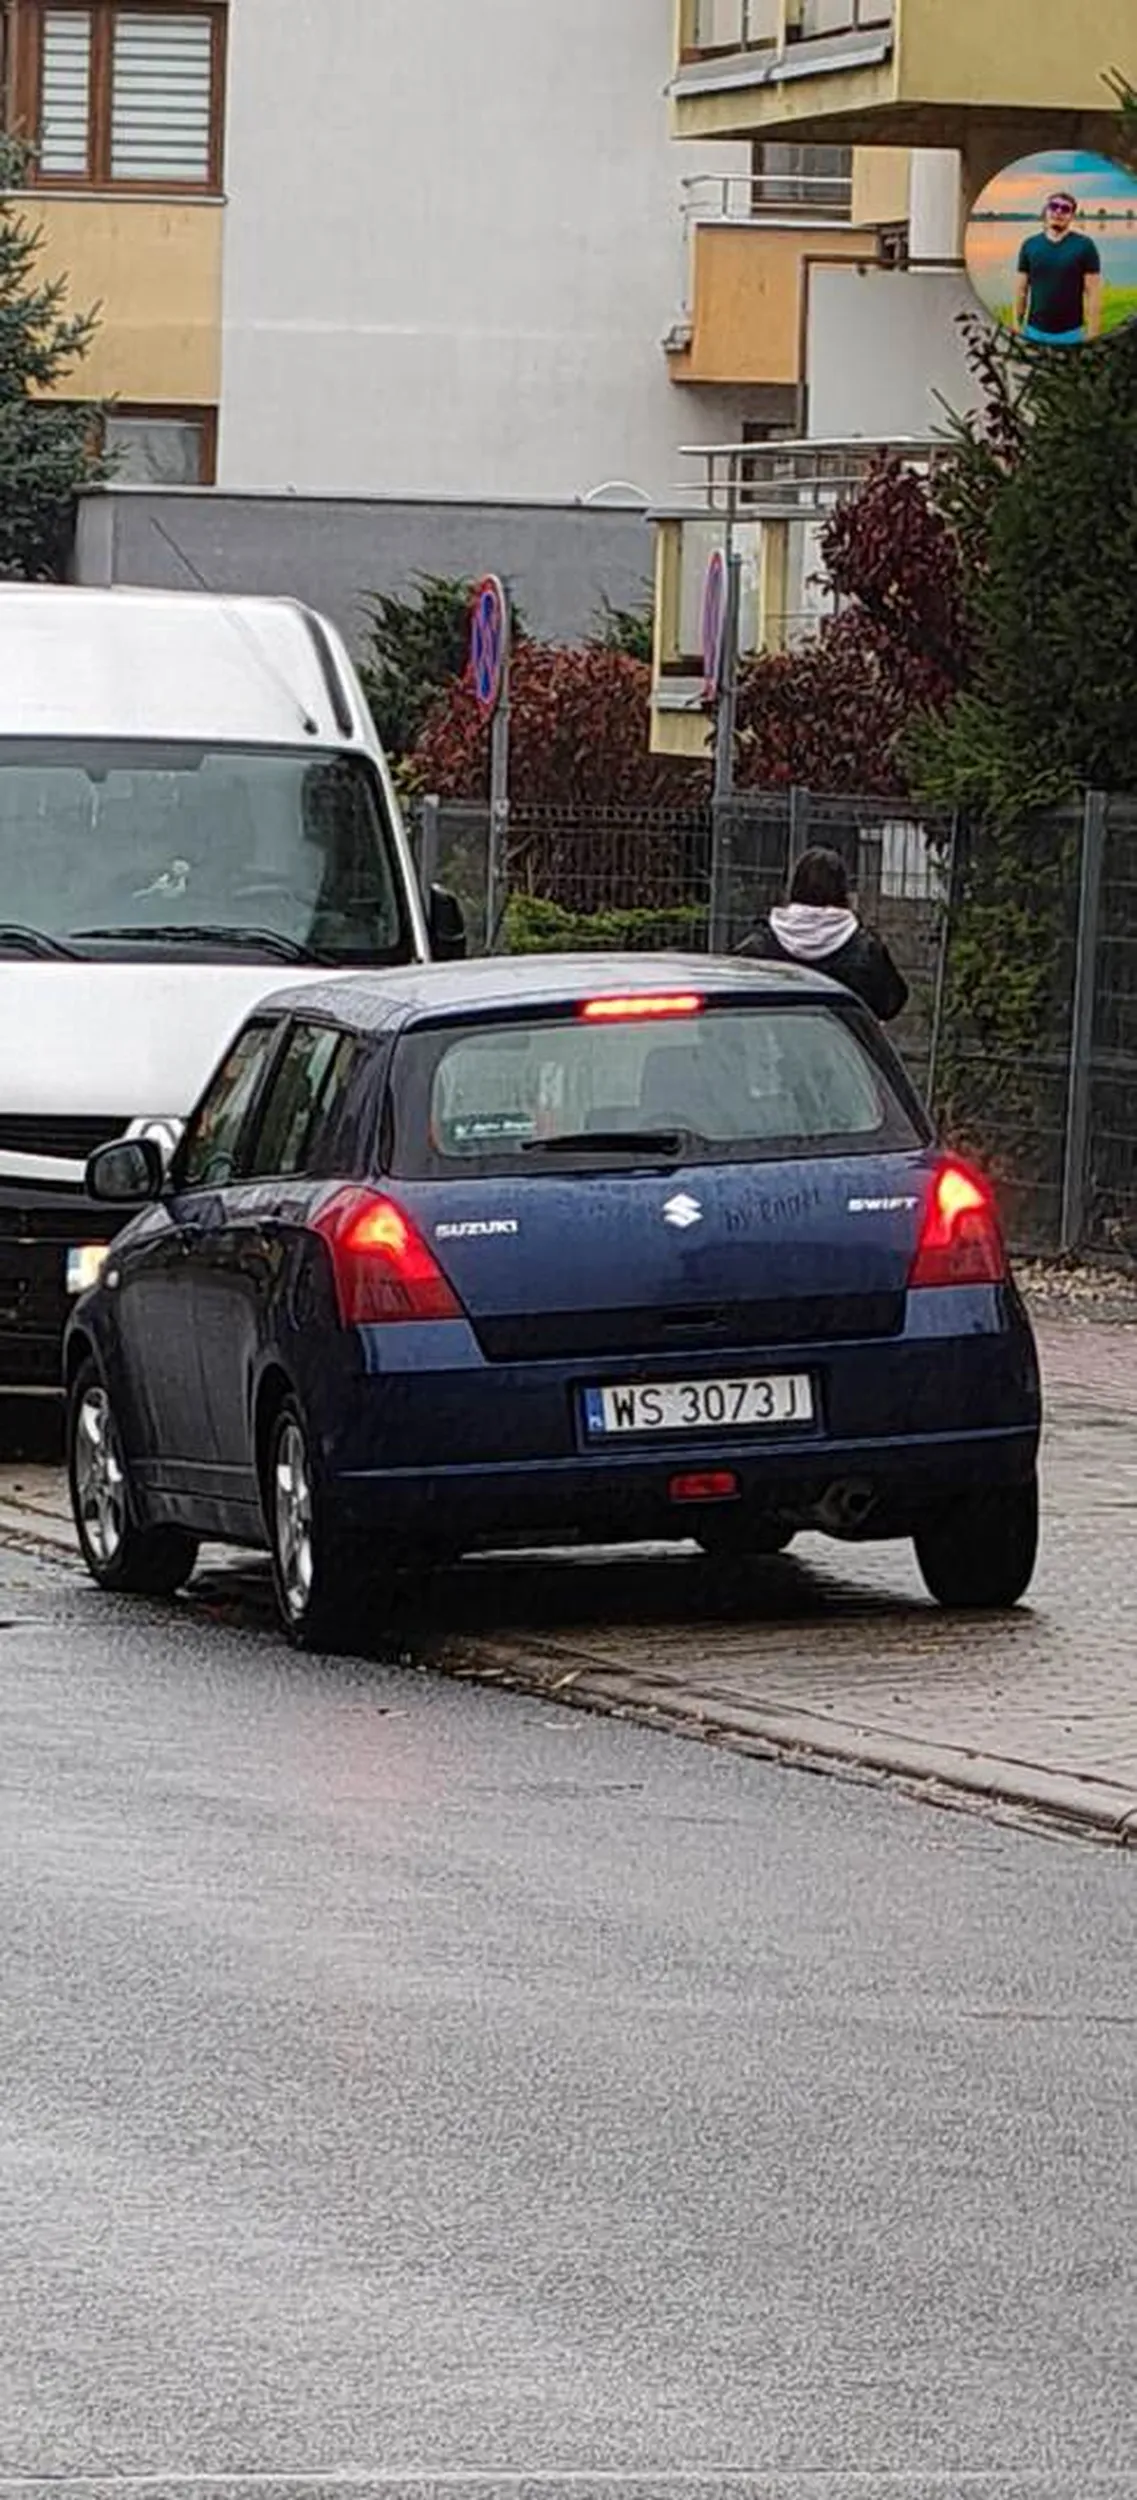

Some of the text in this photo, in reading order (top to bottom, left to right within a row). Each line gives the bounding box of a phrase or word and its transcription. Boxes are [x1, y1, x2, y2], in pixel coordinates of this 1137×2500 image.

[848, 1196, 919, 1212] SWIFT
[434, 1219, 518, 1238] SUZUKI
[611, 1378, 796, 1427] WS 3073J
